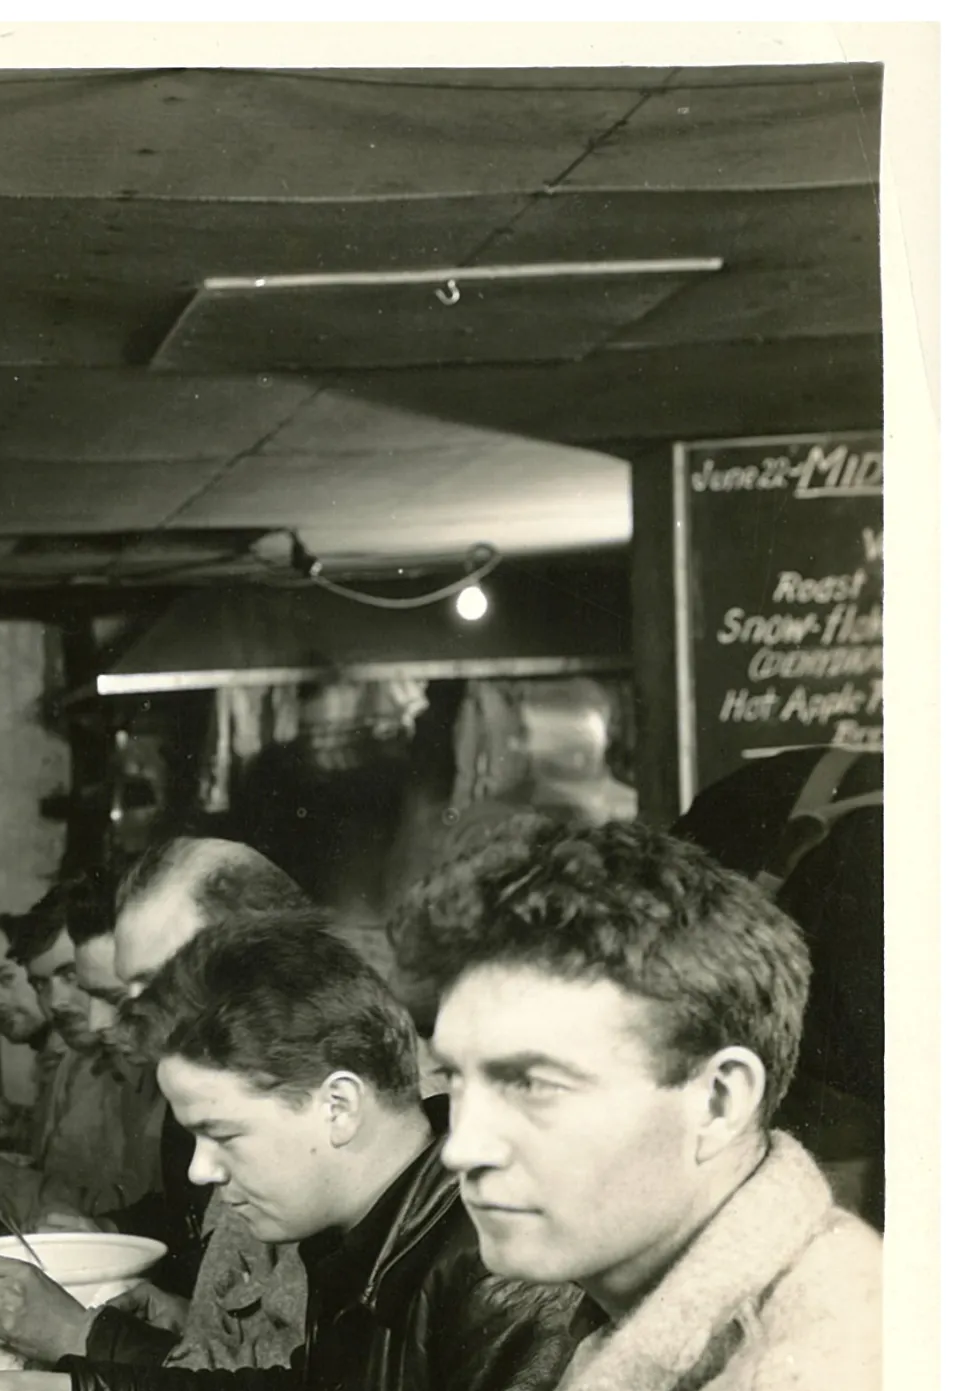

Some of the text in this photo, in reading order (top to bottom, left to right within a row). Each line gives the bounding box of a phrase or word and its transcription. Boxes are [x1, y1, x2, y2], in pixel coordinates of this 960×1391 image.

[691, 459, 759, 492] June
[719, 686, 778, 722] Hot
[779, 682, 866, 726] Apple
